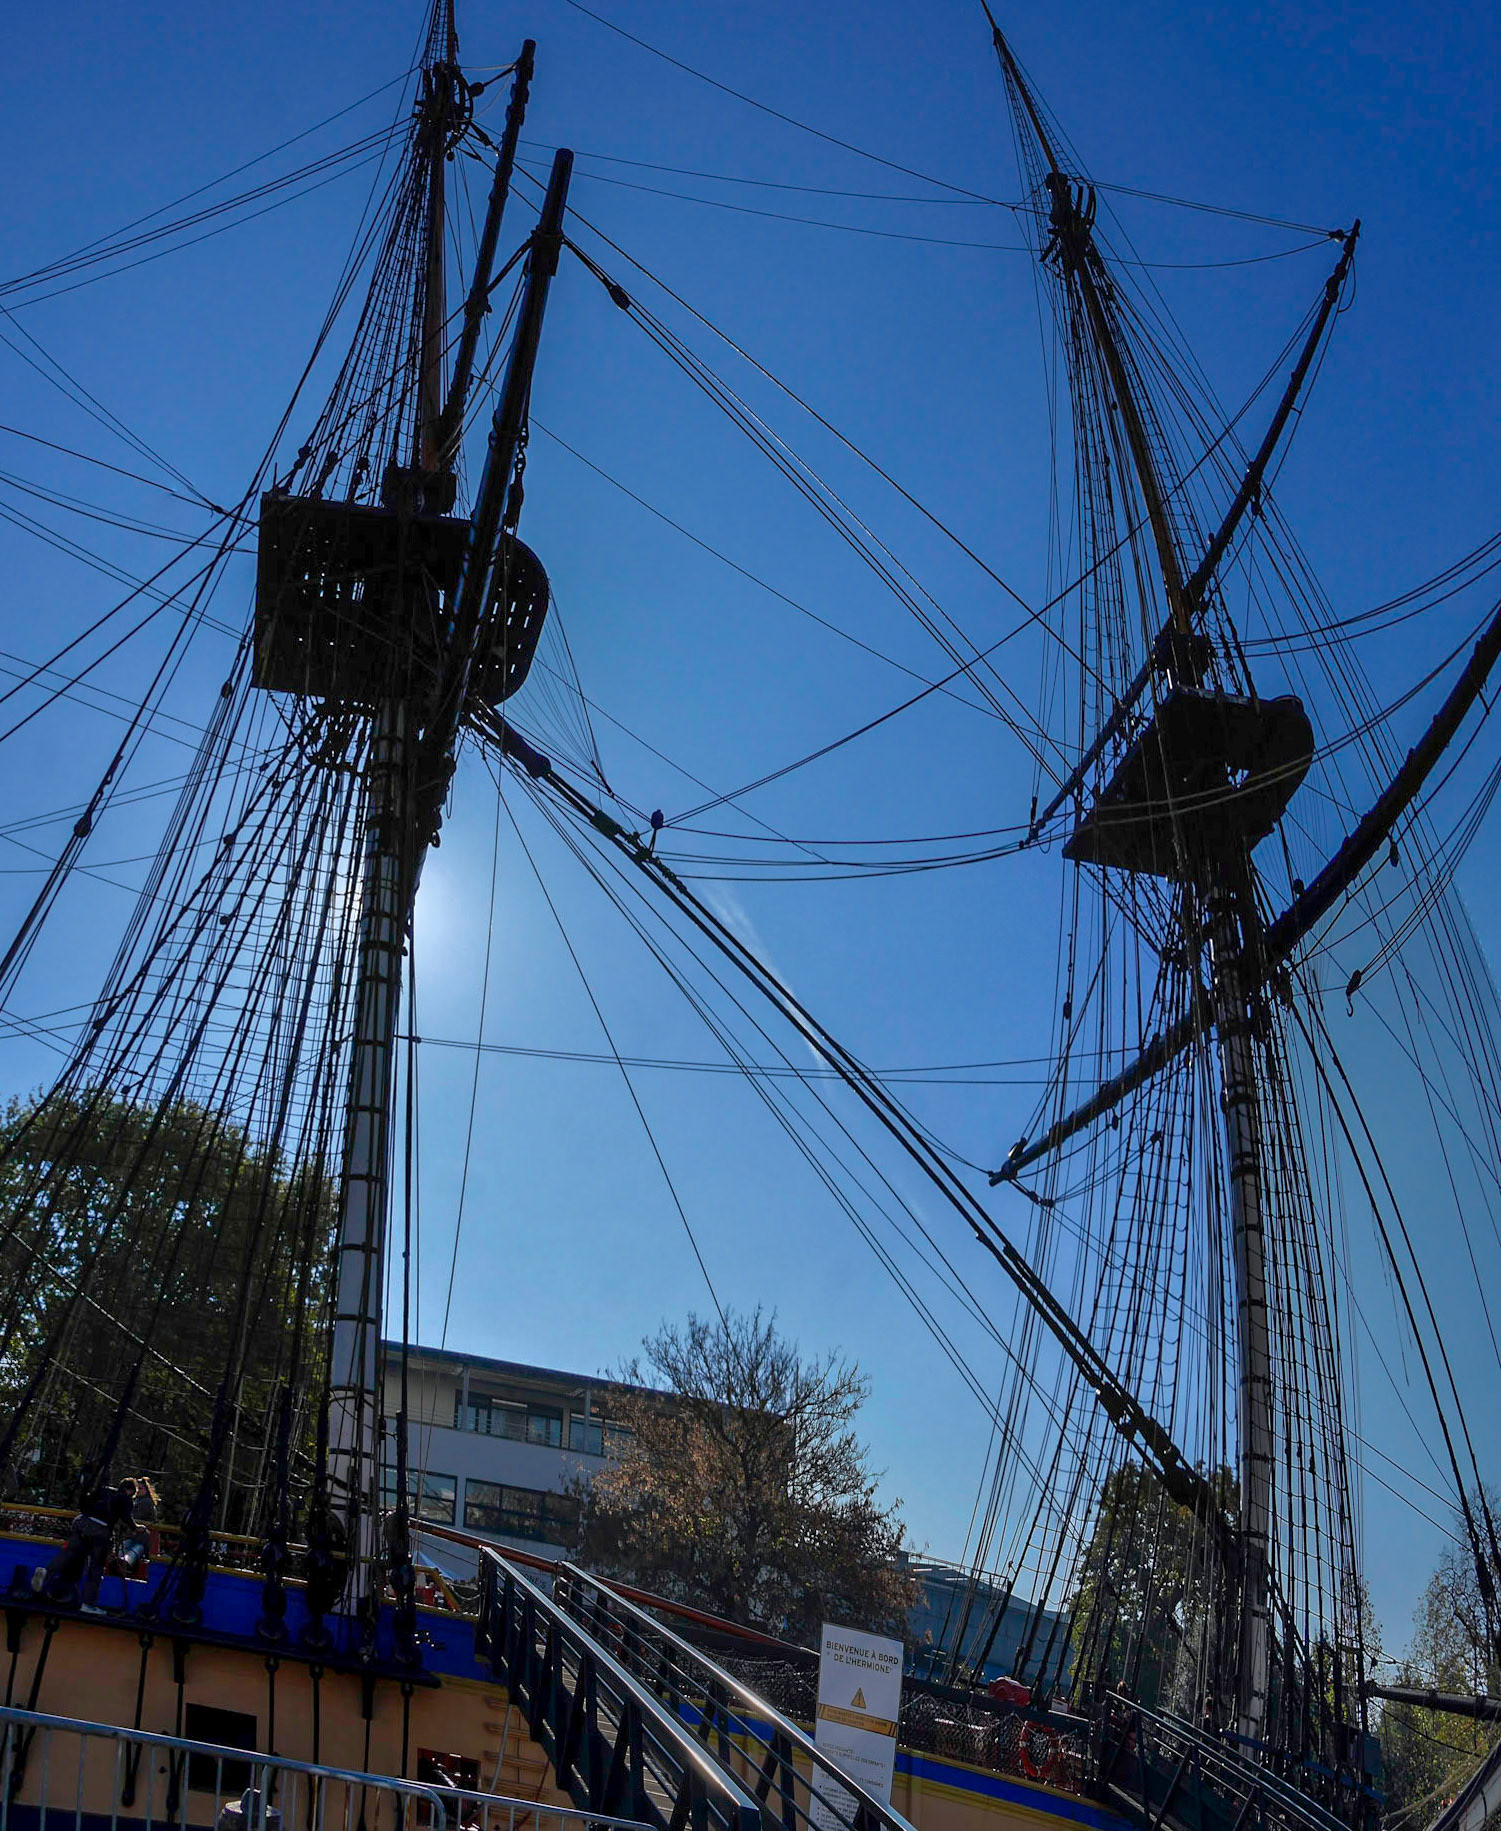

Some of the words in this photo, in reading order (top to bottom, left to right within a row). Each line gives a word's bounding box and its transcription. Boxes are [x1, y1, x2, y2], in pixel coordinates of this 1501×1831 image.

[826, 1640, 869, 1658] BIENVENUE
[871, 1649, 876, 1659] À
[878, 1653, 899, 1665] BORD
[833, 1653, 844, 1662] DE
[845, 1656, 890, 1674] L'HERMIONE
